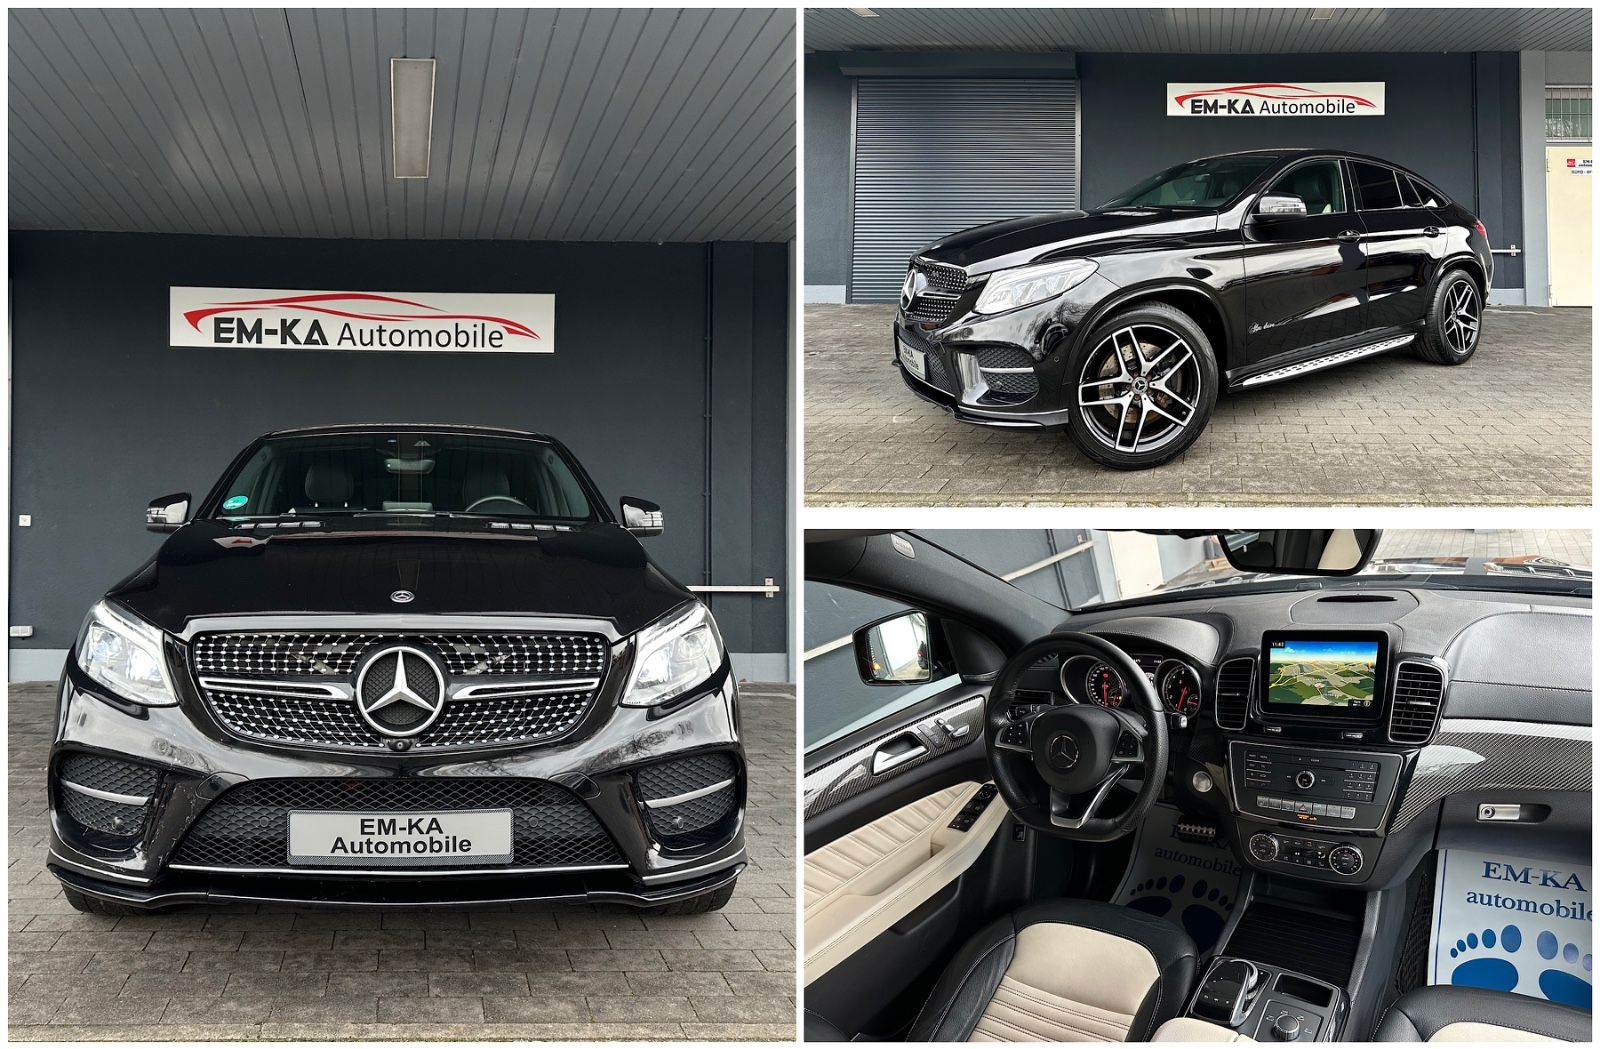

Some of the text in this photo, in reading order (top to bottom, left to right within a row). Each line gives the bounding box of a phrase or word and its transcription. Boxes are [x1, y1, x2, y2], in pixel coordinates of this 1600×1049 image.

[1190, 99, 1356, 115] EM-KA Automobile
[213, 316, 504, 348] EM-KA Automobile
[360, 817, 444, 836] EM-KA
[330, 835, 472, 854] Automobile
[1154, 847, 1241, 877] automobile
[1482, 860, 1588, 892] EM-KA
